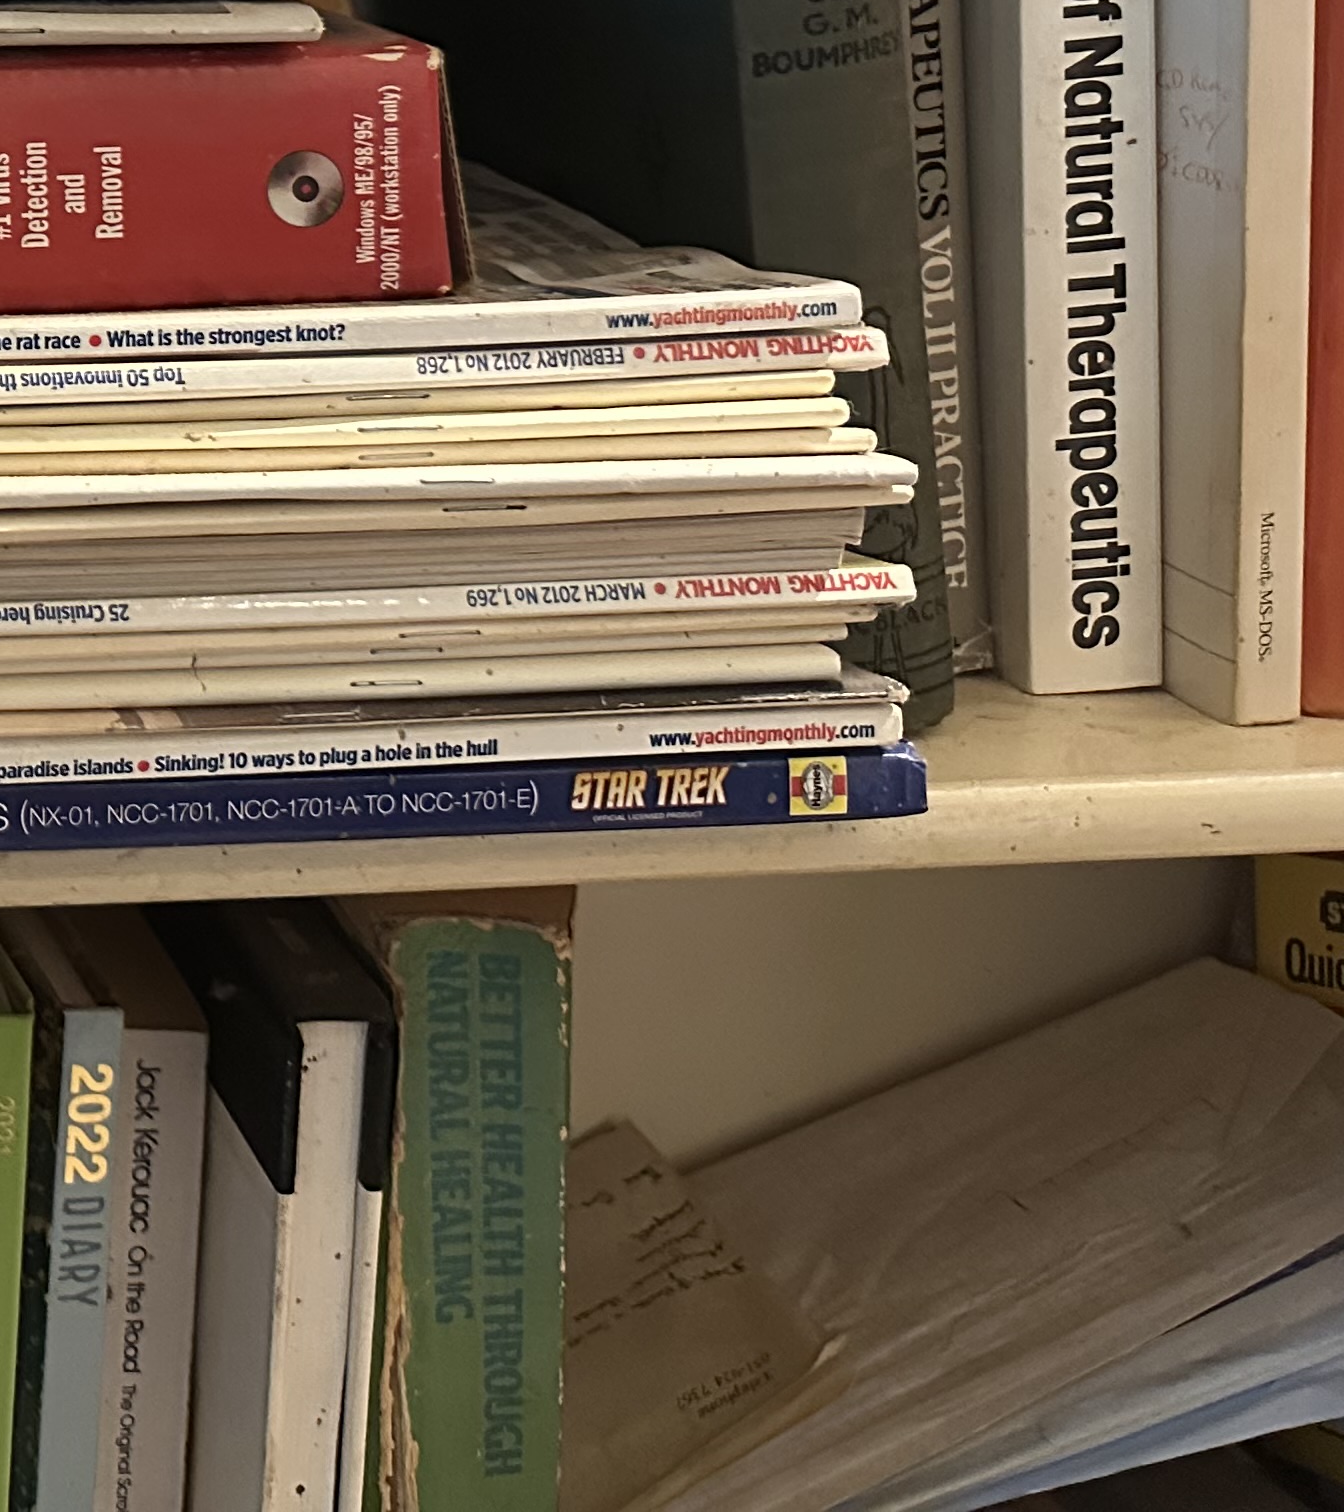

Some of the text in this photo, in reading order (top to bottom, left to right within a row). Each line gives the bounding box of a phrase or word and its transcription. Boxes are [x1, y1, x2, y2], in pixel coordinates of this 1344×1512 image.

[92, 144, 124, 241] Removal
[378, 83, 404, 292] 2000/NT (workstation only)
[1062, 36, 1127, 254] Natural
[18, 141, 51, 249] Detection
[56, 172, 86, 215] and
[354, 197, 376, 265] Windows
[605, 299, 838, 329] www.yachtingmonthly.com
[918, 225, 956, 320] VOL
[14, 333, 41, 351] rat
[42, 334, 82, 352] race
[924, 321, 957, 366] II
[929, 365, 970, 589] PRACTICE
[1054, 262, 1132, 651] Therapeutics
[648, 720, 876, 750] www.yachtingmonthly.com
[107, 800, 221, 828] NCC-1701,
[227, 794, 359, 822] NCC-1701-A
[365, 793, 395, 817] TO
[401, 786, 540, 817] NCC-1701-E)
[570, 765, 732, 811] STAR TREK
[810, 763, 823, 808] Haynes
[58, 1062, 114, 1309] 2022 DIARY
[426, 949, 476, 1326] NATURAL HEALING
[122, 1057, 162, 1374] Jack Kerouac On the Road
[476, 952, 526, 1479] BETTER HEALTH THROUGH
